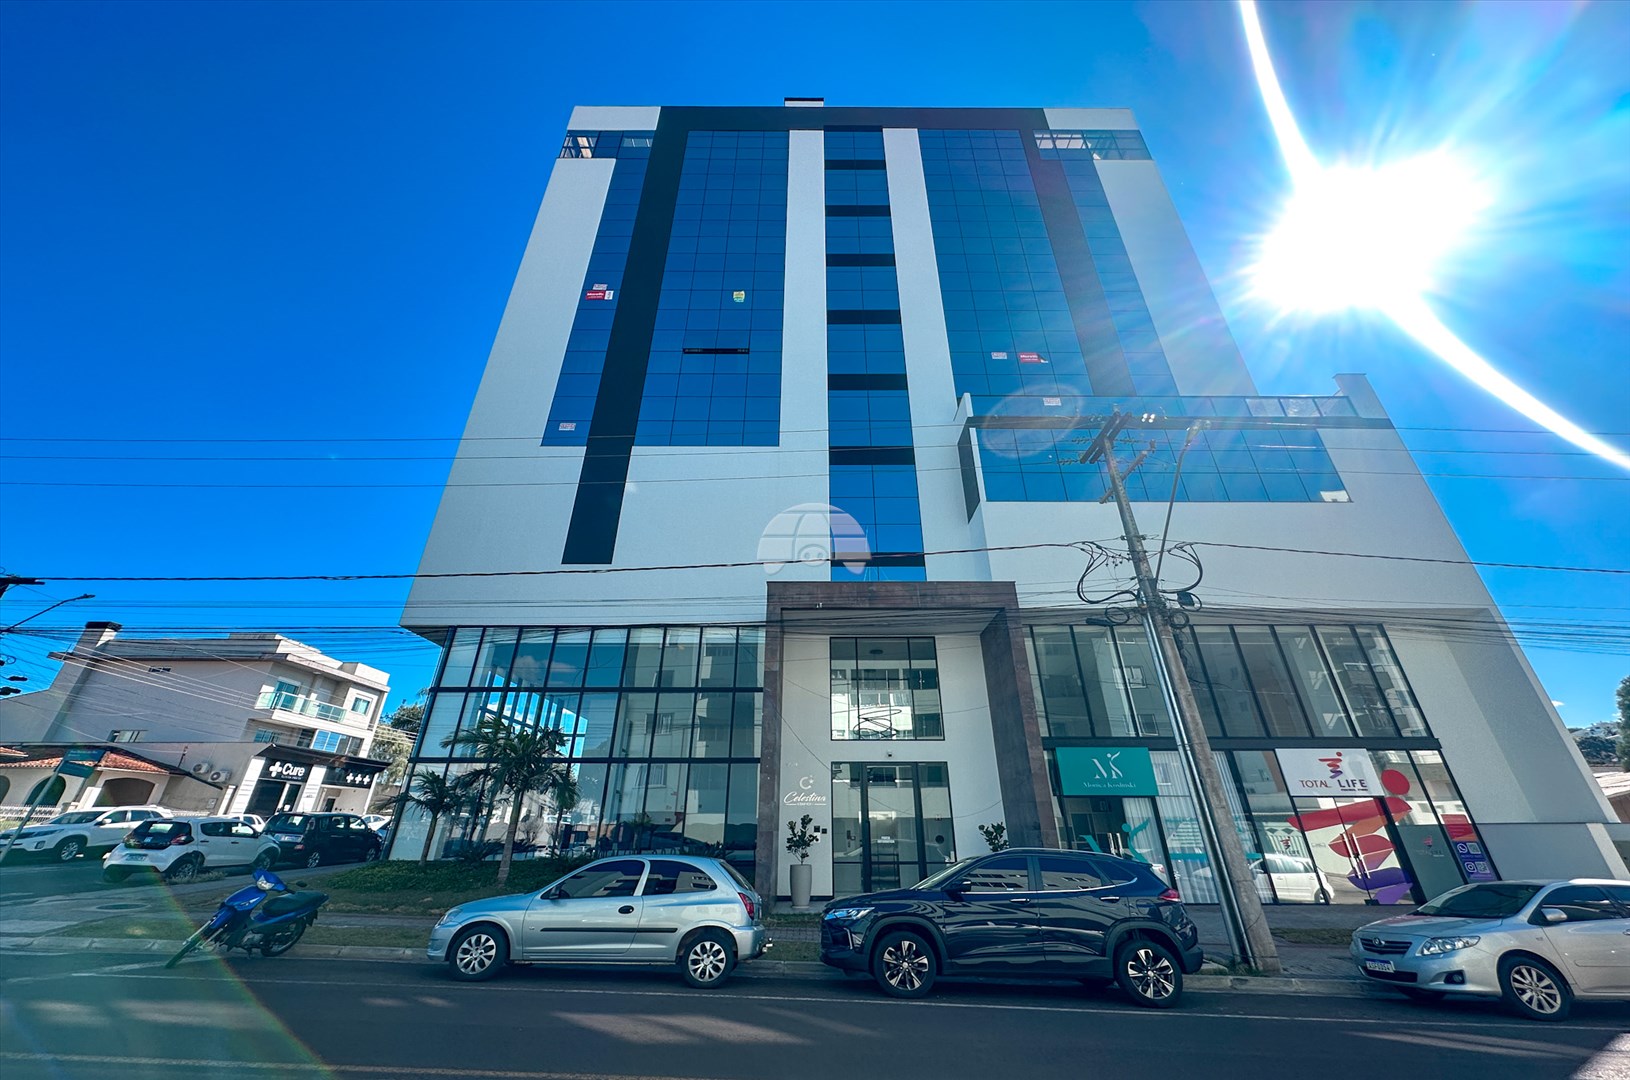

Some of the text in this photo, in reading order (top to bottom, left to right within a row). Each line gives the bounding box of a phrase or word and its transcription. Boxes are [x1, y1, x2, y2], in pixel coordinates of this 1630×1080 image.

[282, 763, 305, 776] Cure
[1299, 779, 1368, 788] TOTAL LIFE
